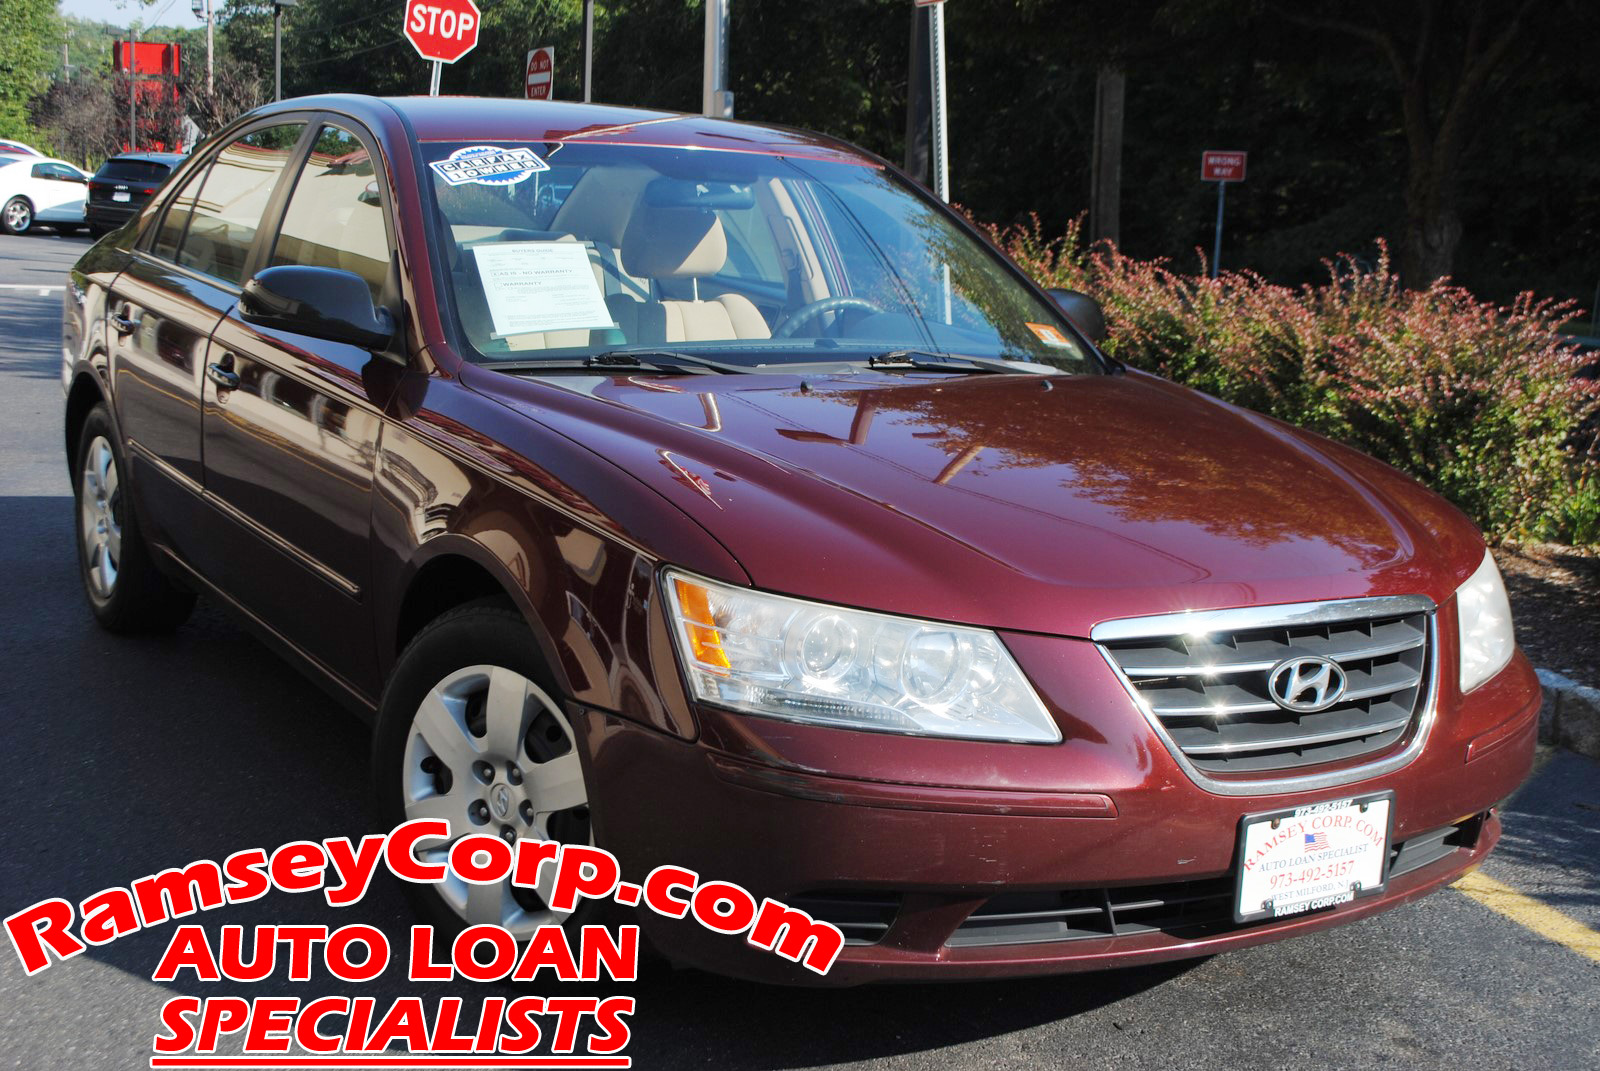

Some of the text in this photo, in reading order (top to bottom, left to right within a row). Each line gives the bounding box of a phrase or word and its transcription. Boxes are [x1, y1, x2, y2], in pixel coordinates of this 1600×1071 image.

[411, 4, 474, 40] STOP
[540, 59, 550, 69] NOT
[531, 85, 546, 97] ENTER
[441, 153, 530, 172] CARFAX
[465, 161, 540, 178] OWNER
[1213, 168, 1232, 176] WAY
[1243, 819, 1307, 871] RAMSEY
[1356, 819, 1384, 847] COM
[1259, 843, 1369, 873] AUTO LOAN SPECIALIST
[1270, 860, 1355, 891] 973-492-5157
[1271, 891, 1295, 904] WEST
[1274, 892, 1354, 917] RAMSEY CORP.COM
